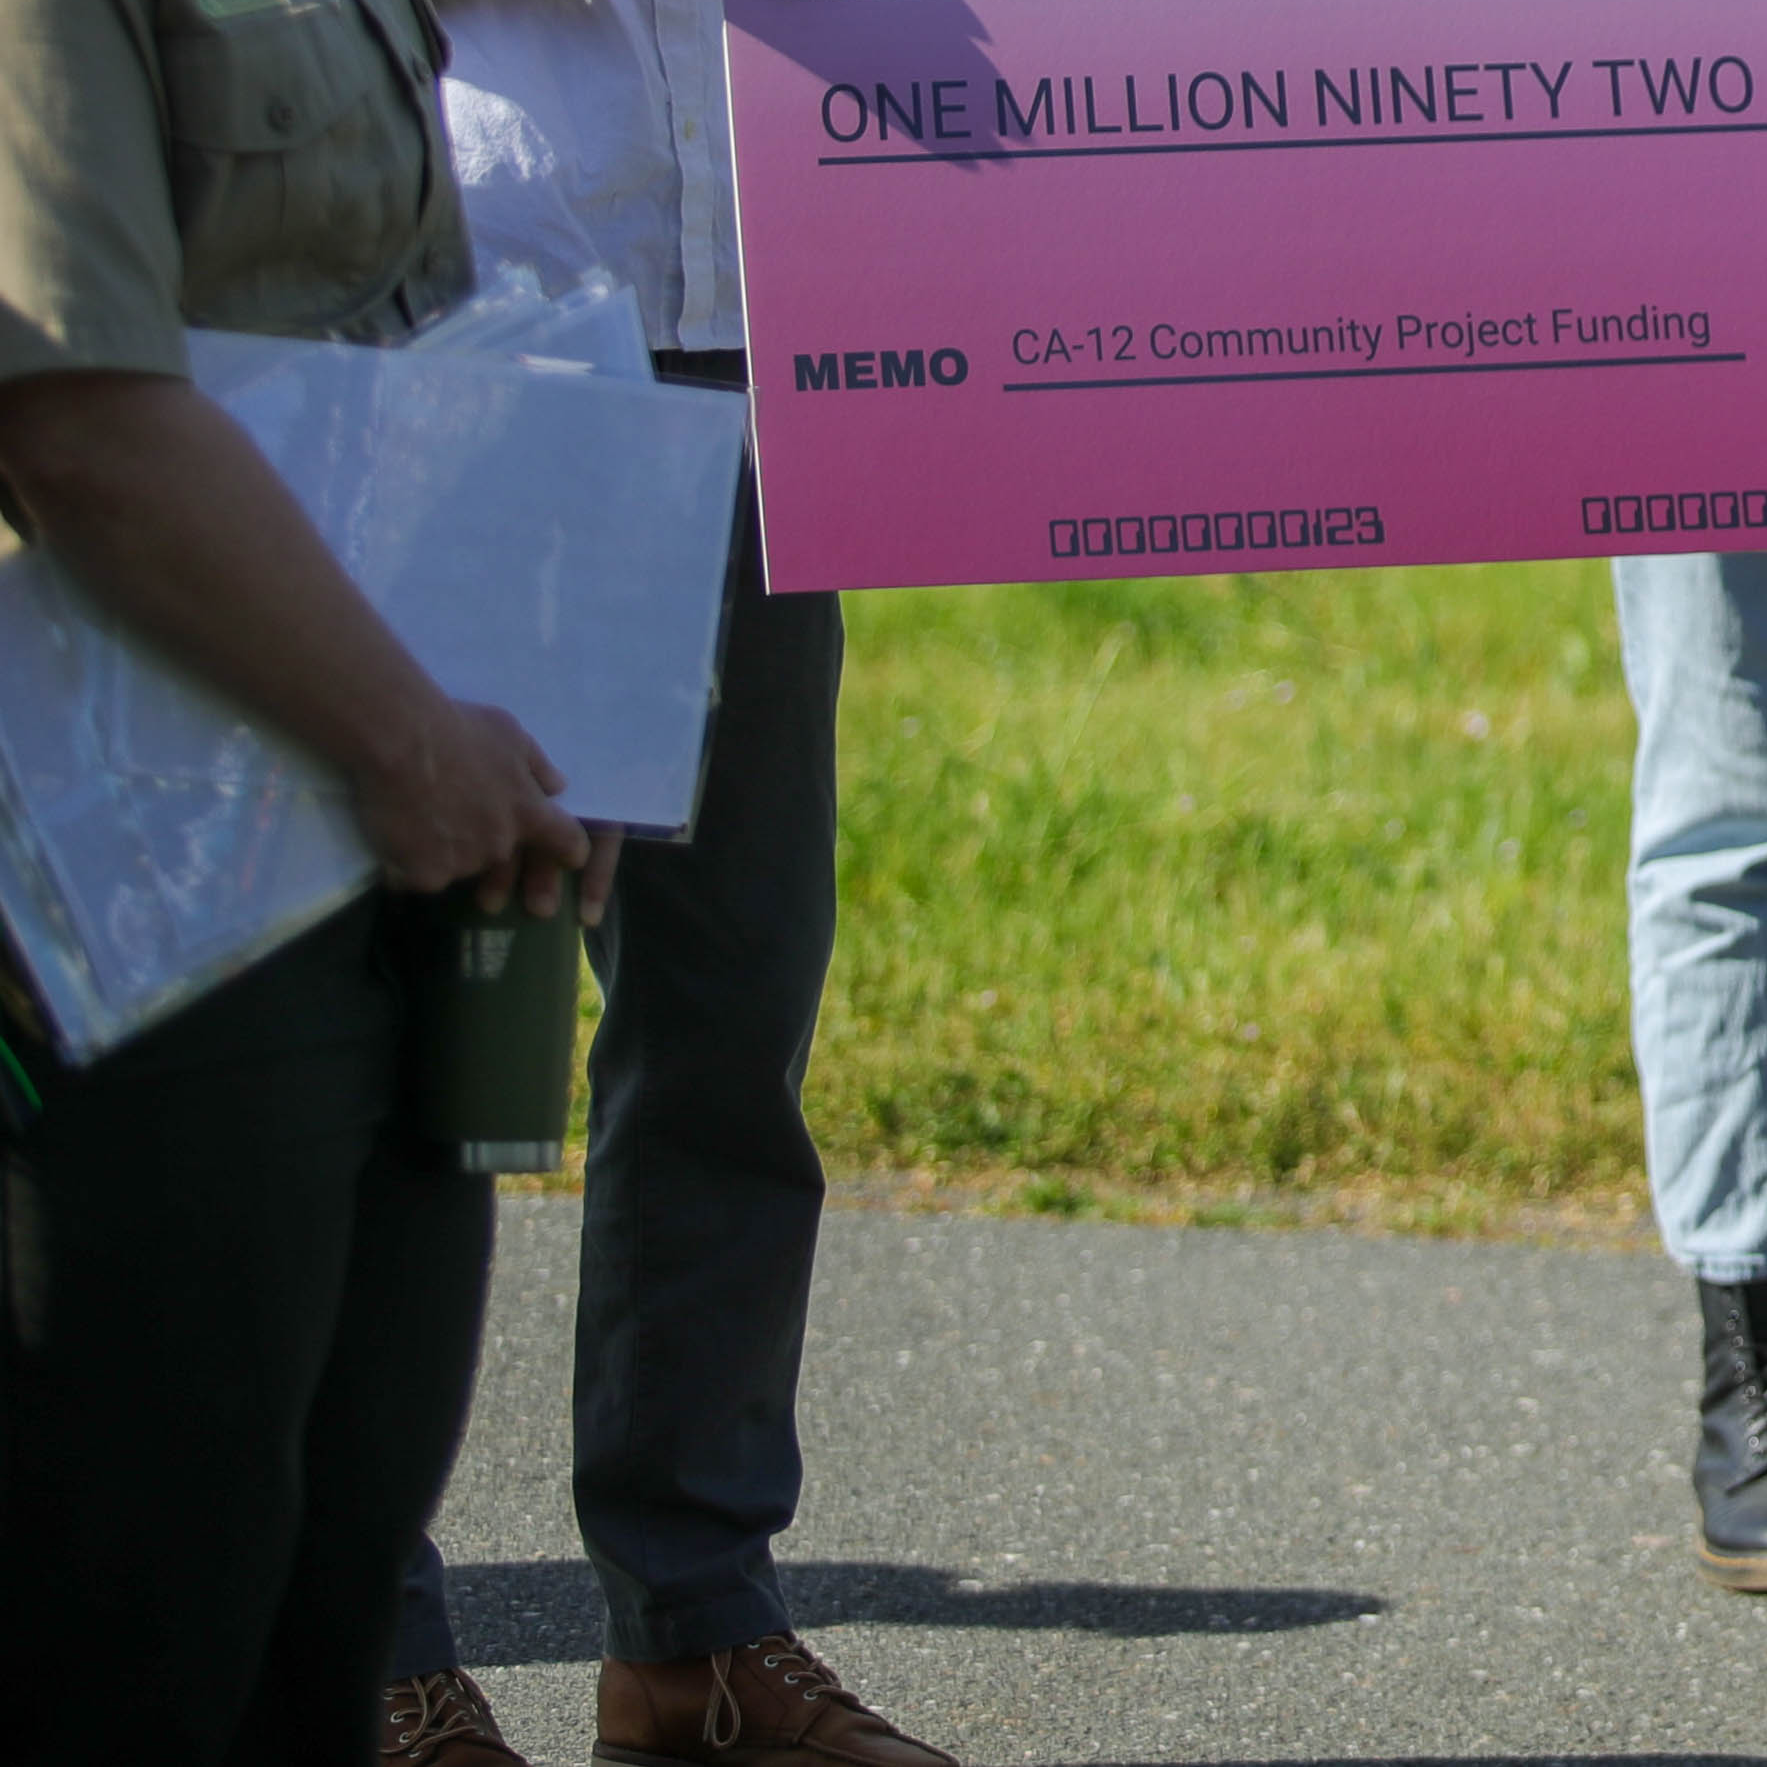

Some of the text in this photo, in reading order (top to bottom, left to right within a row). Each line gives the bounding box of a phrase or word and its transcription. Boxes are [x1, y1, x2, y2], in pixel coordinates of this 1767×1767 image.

[821, 79, 973, 143] ONE
[995, 69, 1289, 138] MILLION
[1314, 60, 1574, 126] NINETY
[1592, 54, 1754, 117] TWO
[1011, 303, 1712, 366] CA-12 Community Project Funding
[793, 347, 970, 392] MEMO
